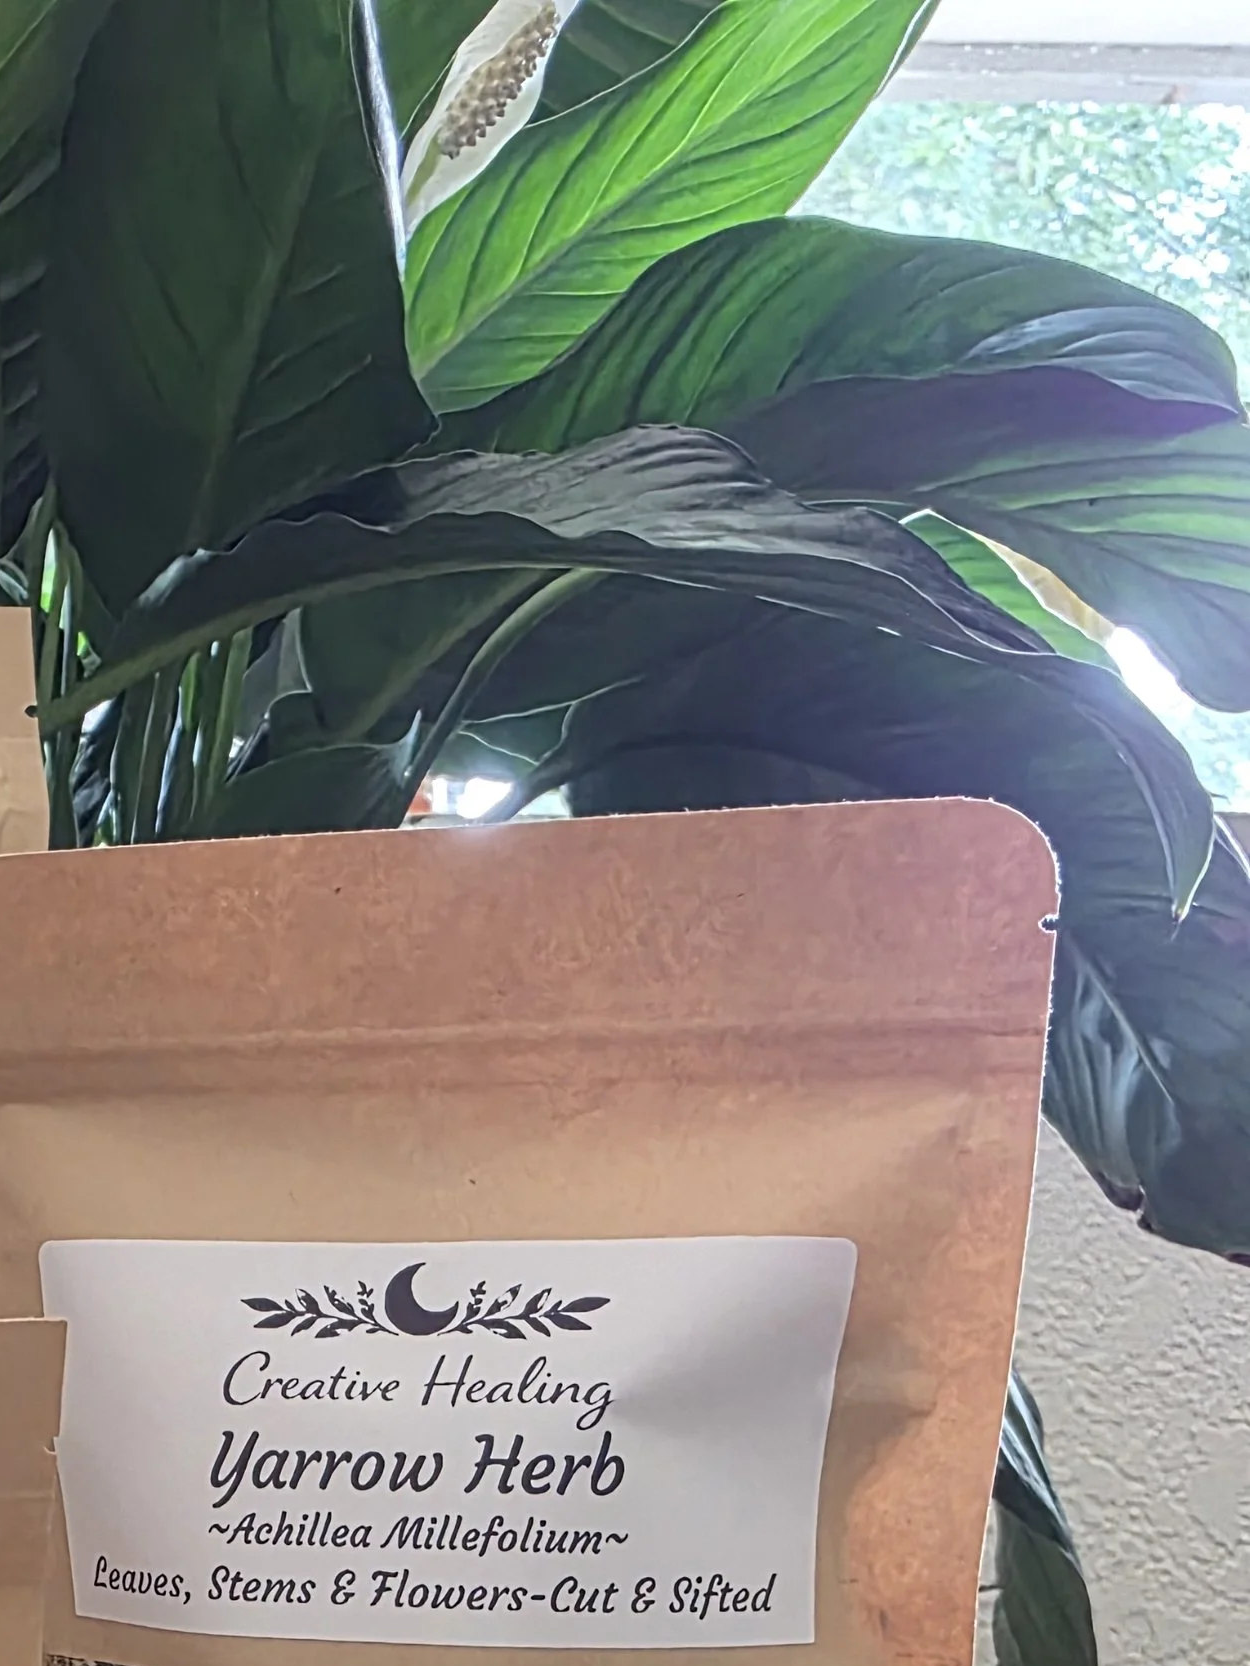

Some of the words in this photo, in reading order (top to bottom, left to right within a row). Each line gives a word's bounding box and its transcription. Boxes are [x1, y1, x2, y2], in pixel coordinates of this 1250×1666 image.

[223, 1351, 400, 1405] Creative
[421, 1354, 615, 1430] Healing
[210, 1431, 443, 1508] Yarrow
[464, 1431, 624, 1496] Herb
[94, 1556, 191, 1605] Leaves,
[208, 1565, 316, 1603] Stems
[331, 1569, 356, 1605] &
[370, 1569, 619, 1613] Flowers-Cut
[631, 1577, 656, 1613] &
[669, 1573, 777, 1620] Sifted
